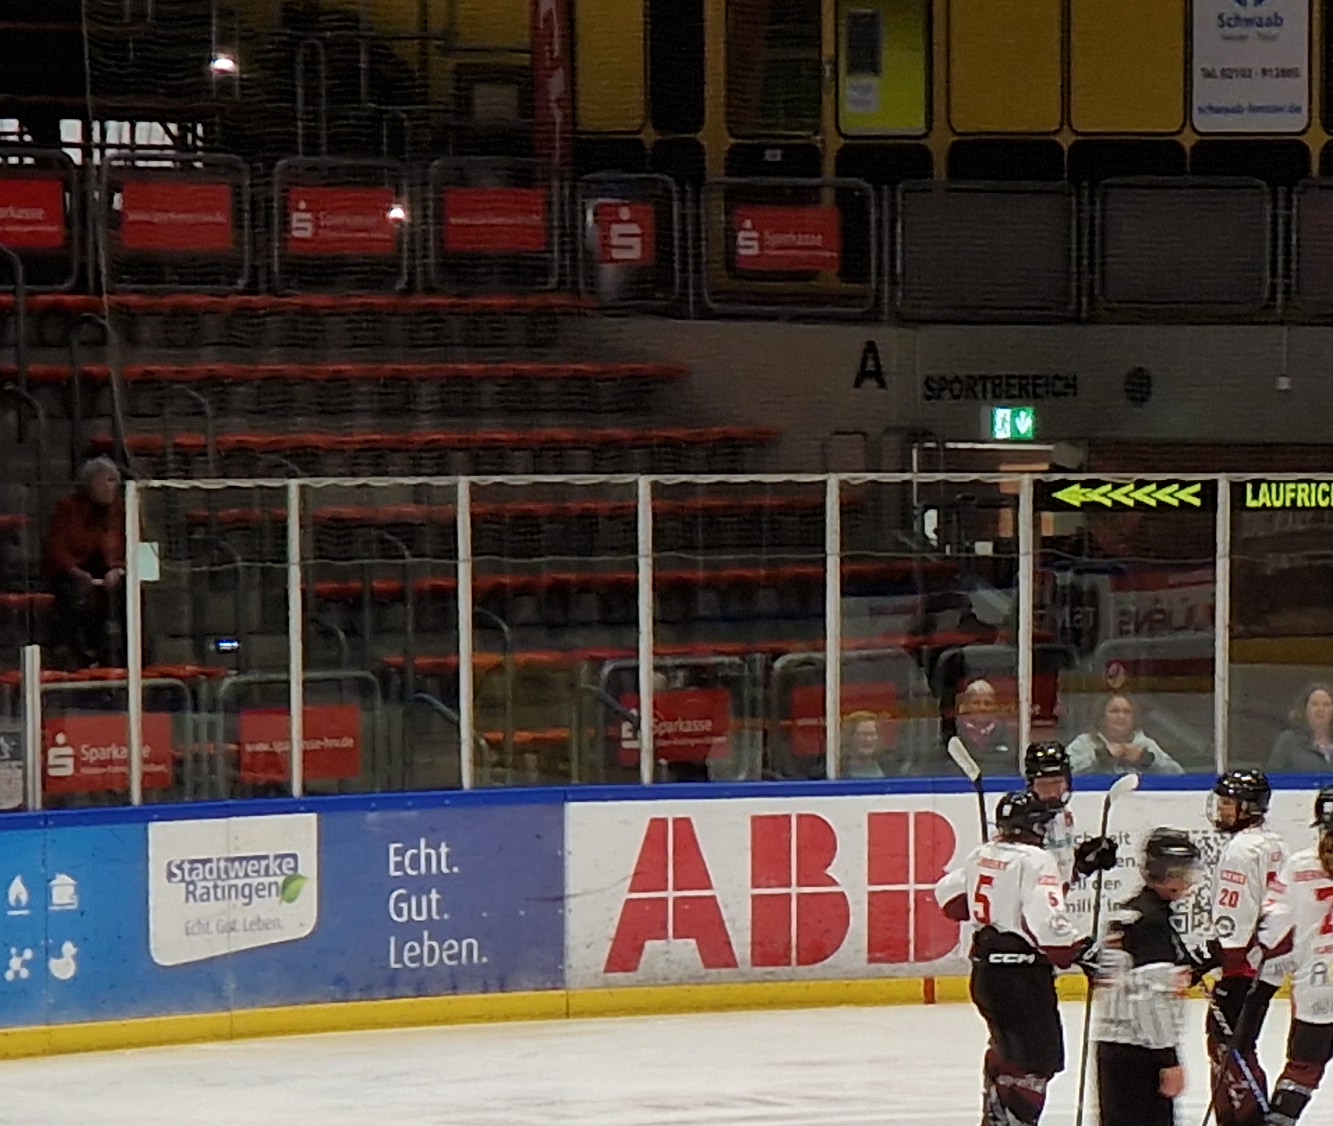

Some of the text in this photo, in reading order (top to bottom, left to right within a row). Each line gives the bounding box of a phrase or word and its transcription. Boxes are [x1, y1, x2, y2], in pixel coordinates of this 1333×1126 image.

[1217, 11, 1284, 28] Schwaab
[853, 340, 888, 390] A
[923, 373, 1078, 401] SPORTBEREICH
[80, 743, 152, 763] Sparkae
[169, 855, 297, 882] Stadtwerke
[388, 838, 460, 877] Echt.
[184, 880, 281, 907] Ratingen
[388, 888, 450, 922] Gut.
[603, 811, 961, 973] ABB
[973, 873, 995, 924] 5
[1219, 888, 1240, 908] 20
[389, 930, 489, 969] Leben.
[988, 953, 1036, 965] CCM
